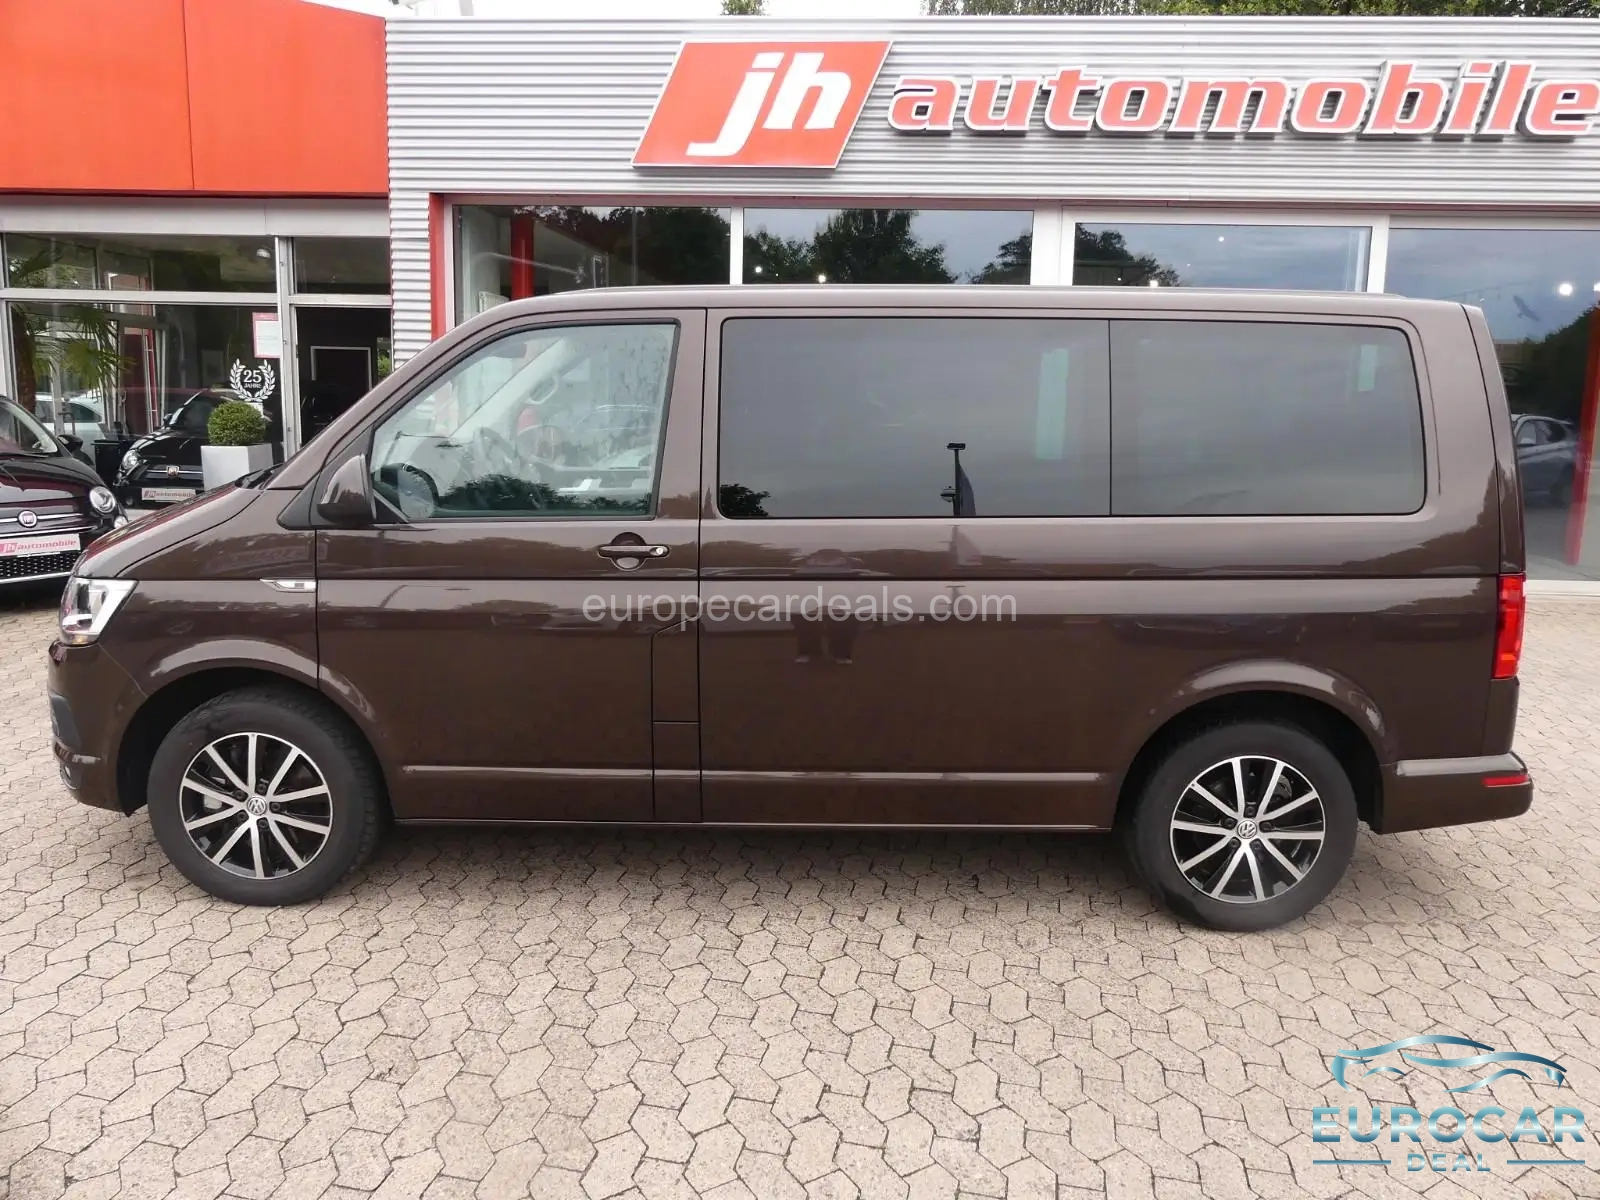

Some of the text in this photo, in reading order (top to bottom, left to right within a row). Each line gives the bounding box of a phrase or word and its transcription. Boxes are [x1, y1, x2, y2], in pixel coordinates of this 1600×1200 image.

[685, 52, 1600, 156] jh automobile
[243, 369, 262, 383] 25
